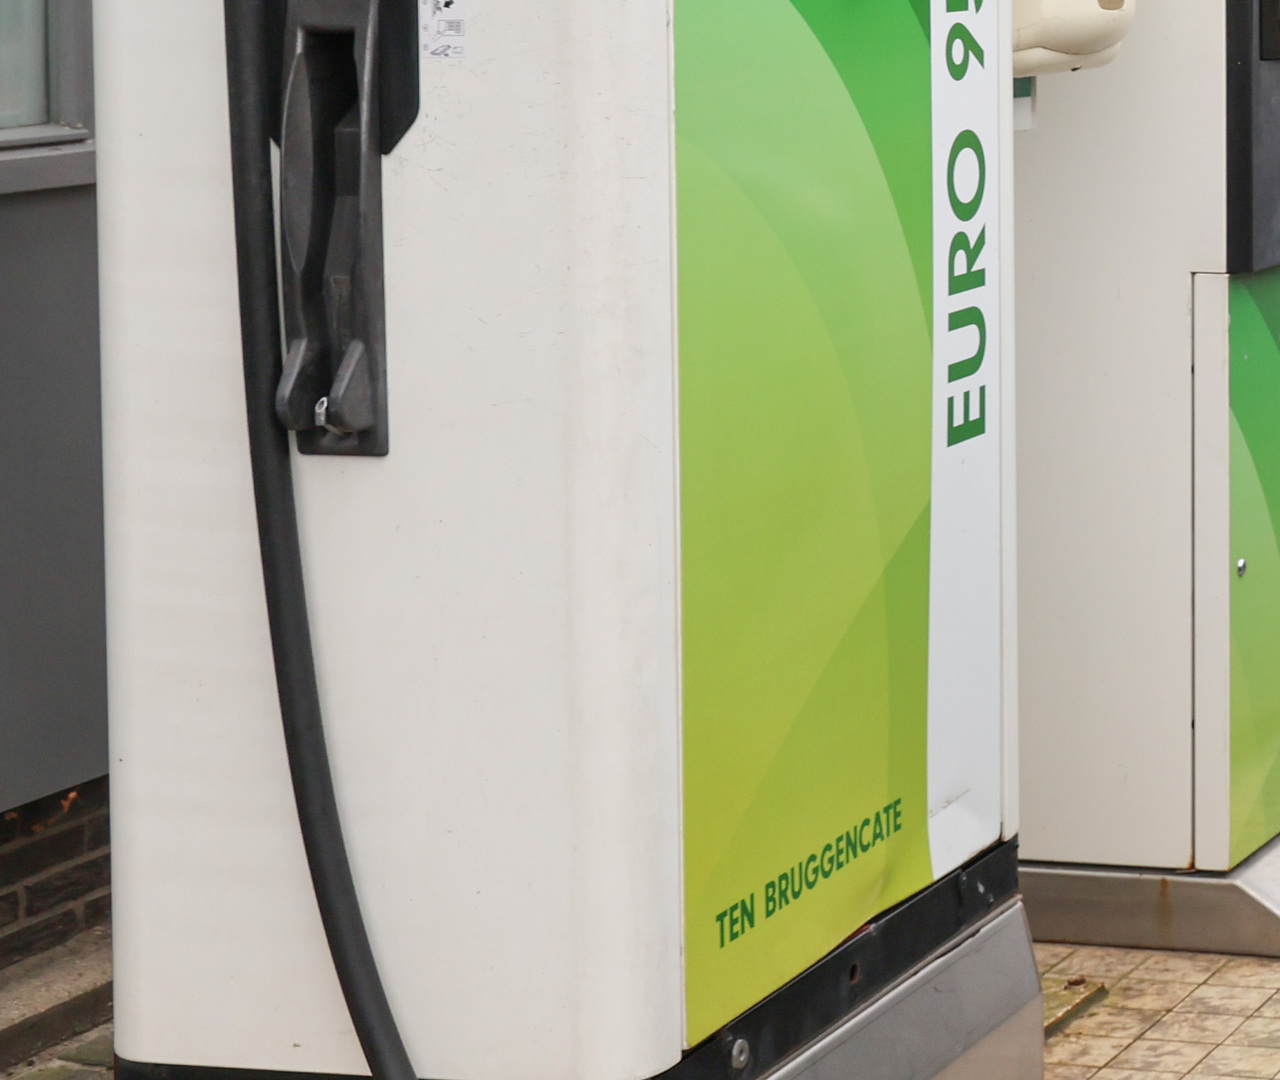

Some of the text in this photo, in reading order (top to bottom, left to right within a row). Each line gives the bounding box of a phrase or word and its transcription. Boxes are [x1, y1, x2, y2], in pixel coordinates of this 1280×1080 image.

[946, 129, 987, 447] EURO
[715, 797, 902, 949] TEN BRUGGENCATE
